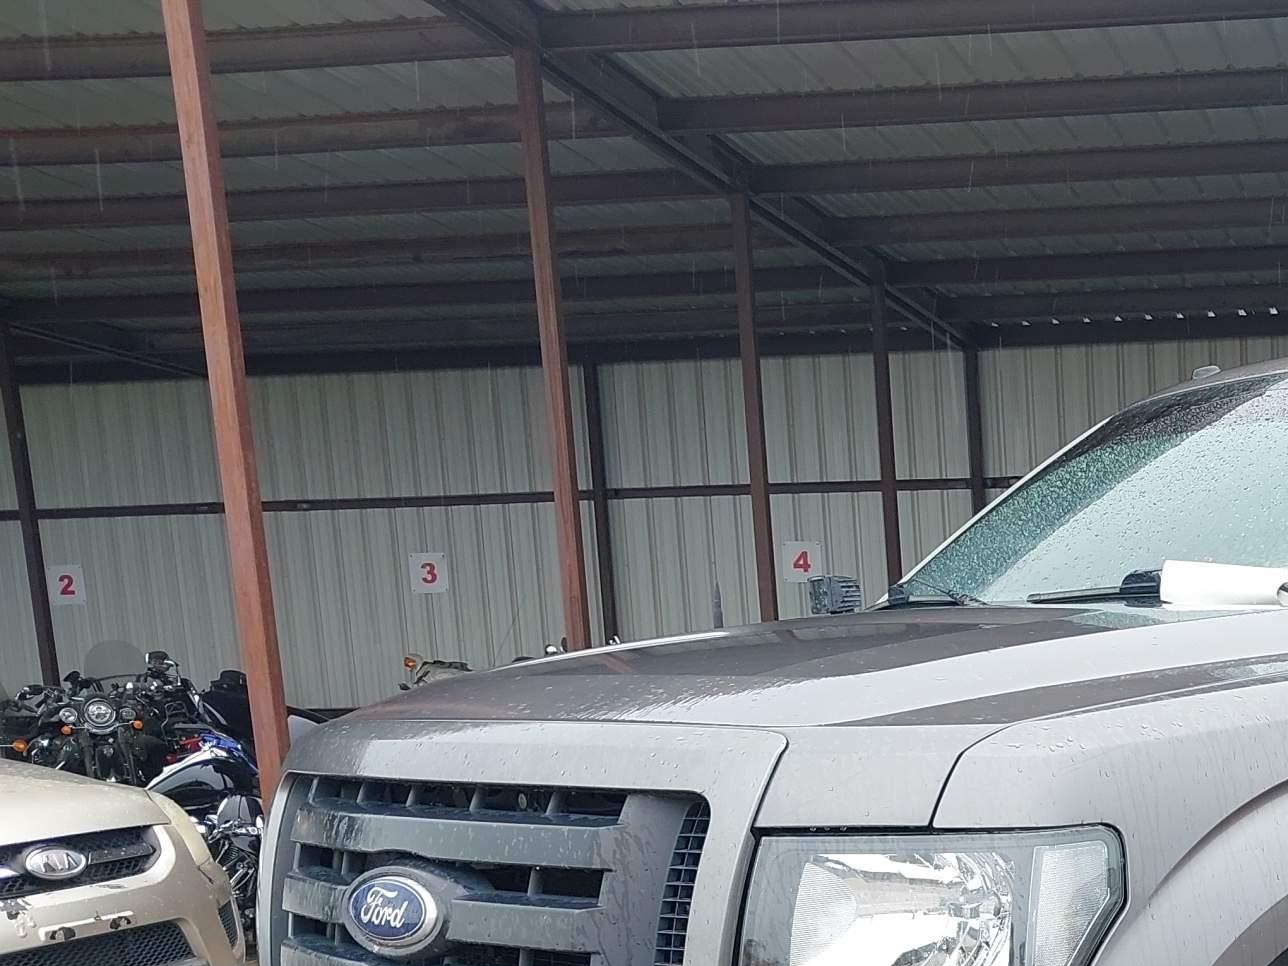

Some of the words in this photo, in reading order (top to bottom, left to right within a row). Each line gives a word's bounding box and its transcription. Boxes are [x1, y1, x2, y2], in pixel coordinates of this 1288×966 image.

[793, 550, 812, 573] 4
[420, 562, 438, 584] 3
[58, 574, 76, 596] 2
[40, 852, 78, 873] KIA
[360, 886, 409, 929] Ford
